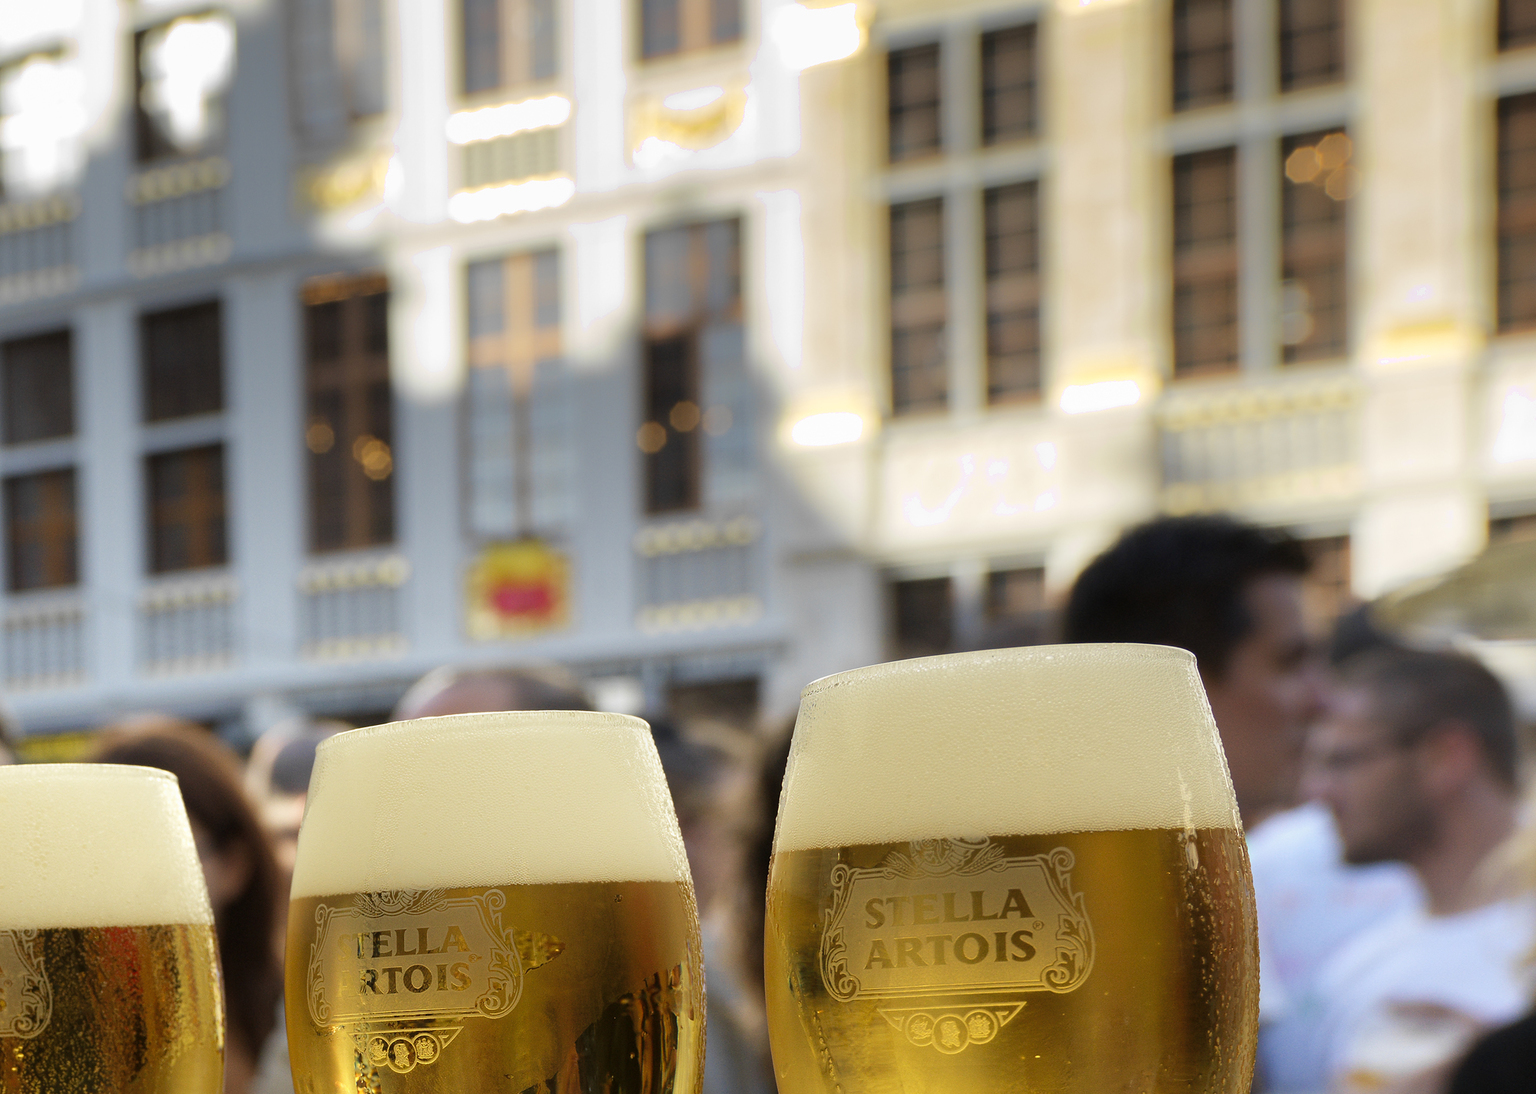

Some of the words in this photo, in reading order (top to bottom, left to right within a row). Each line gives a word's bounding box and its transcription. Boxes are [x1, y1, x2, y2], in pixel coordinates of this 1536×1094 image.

[864, 888, 1036, 930] STELLA
[864, 930, 1037, 970] ARTOIS
[336, 962, 473, 999] RTOIS
